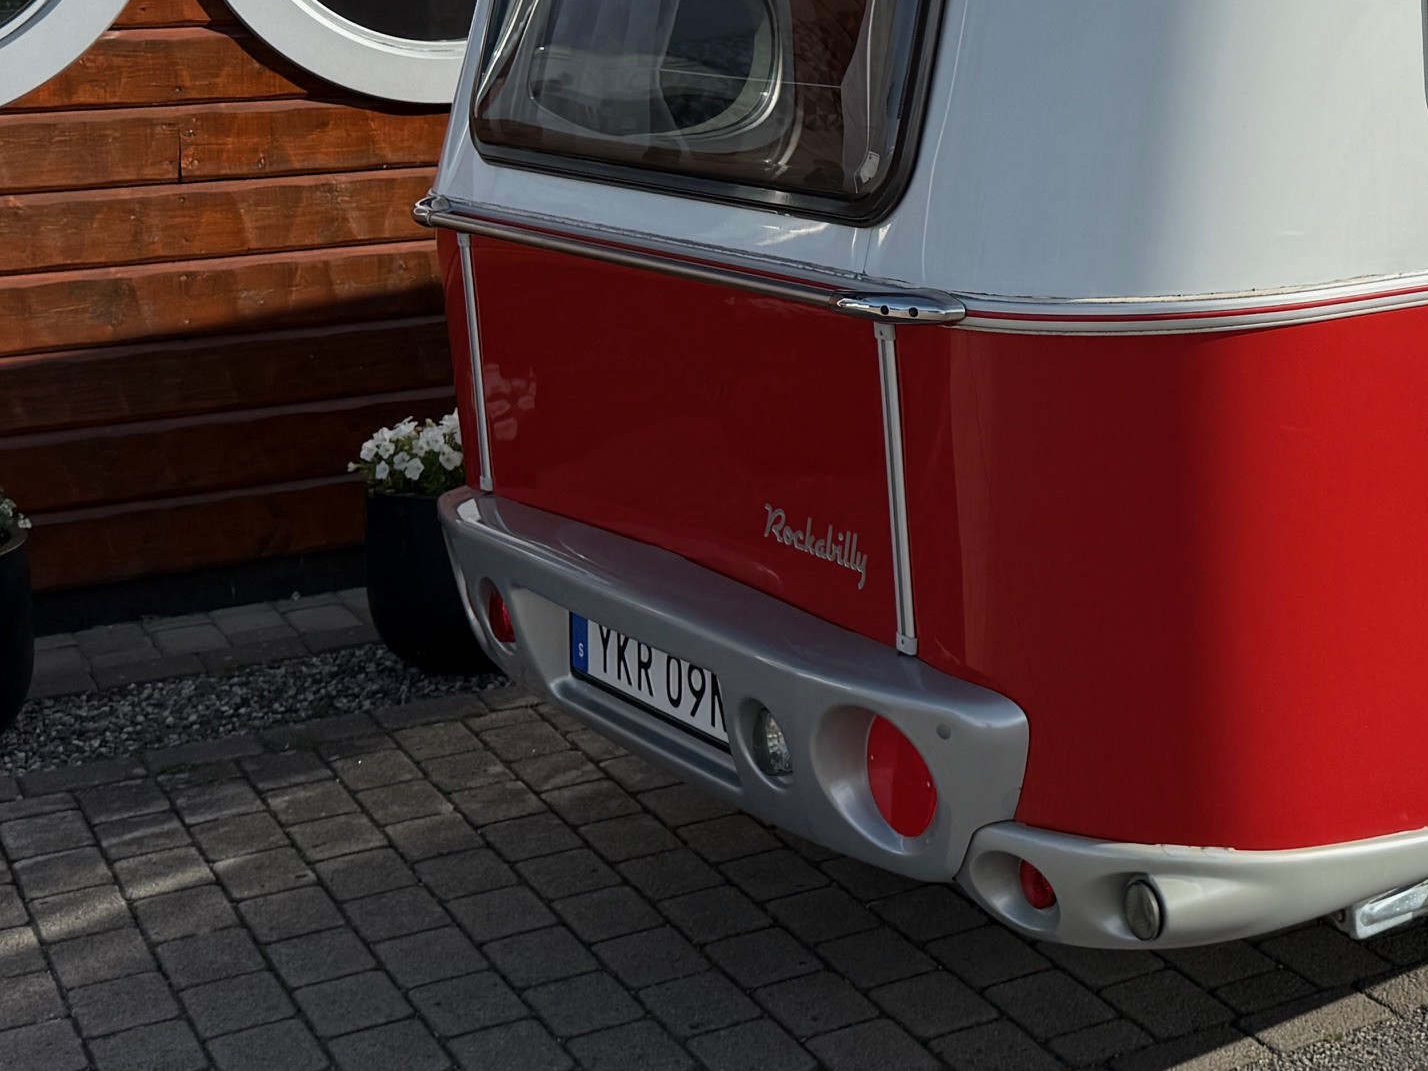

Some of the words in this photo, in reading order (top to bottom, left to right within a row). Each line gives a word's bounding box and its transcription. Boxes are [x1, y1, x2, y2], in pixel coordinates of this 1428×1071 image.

[764, 503, 868, 590] Rockabilly
[578, 642, 584, 658] S
[598, 623, 654, 697] YKR
